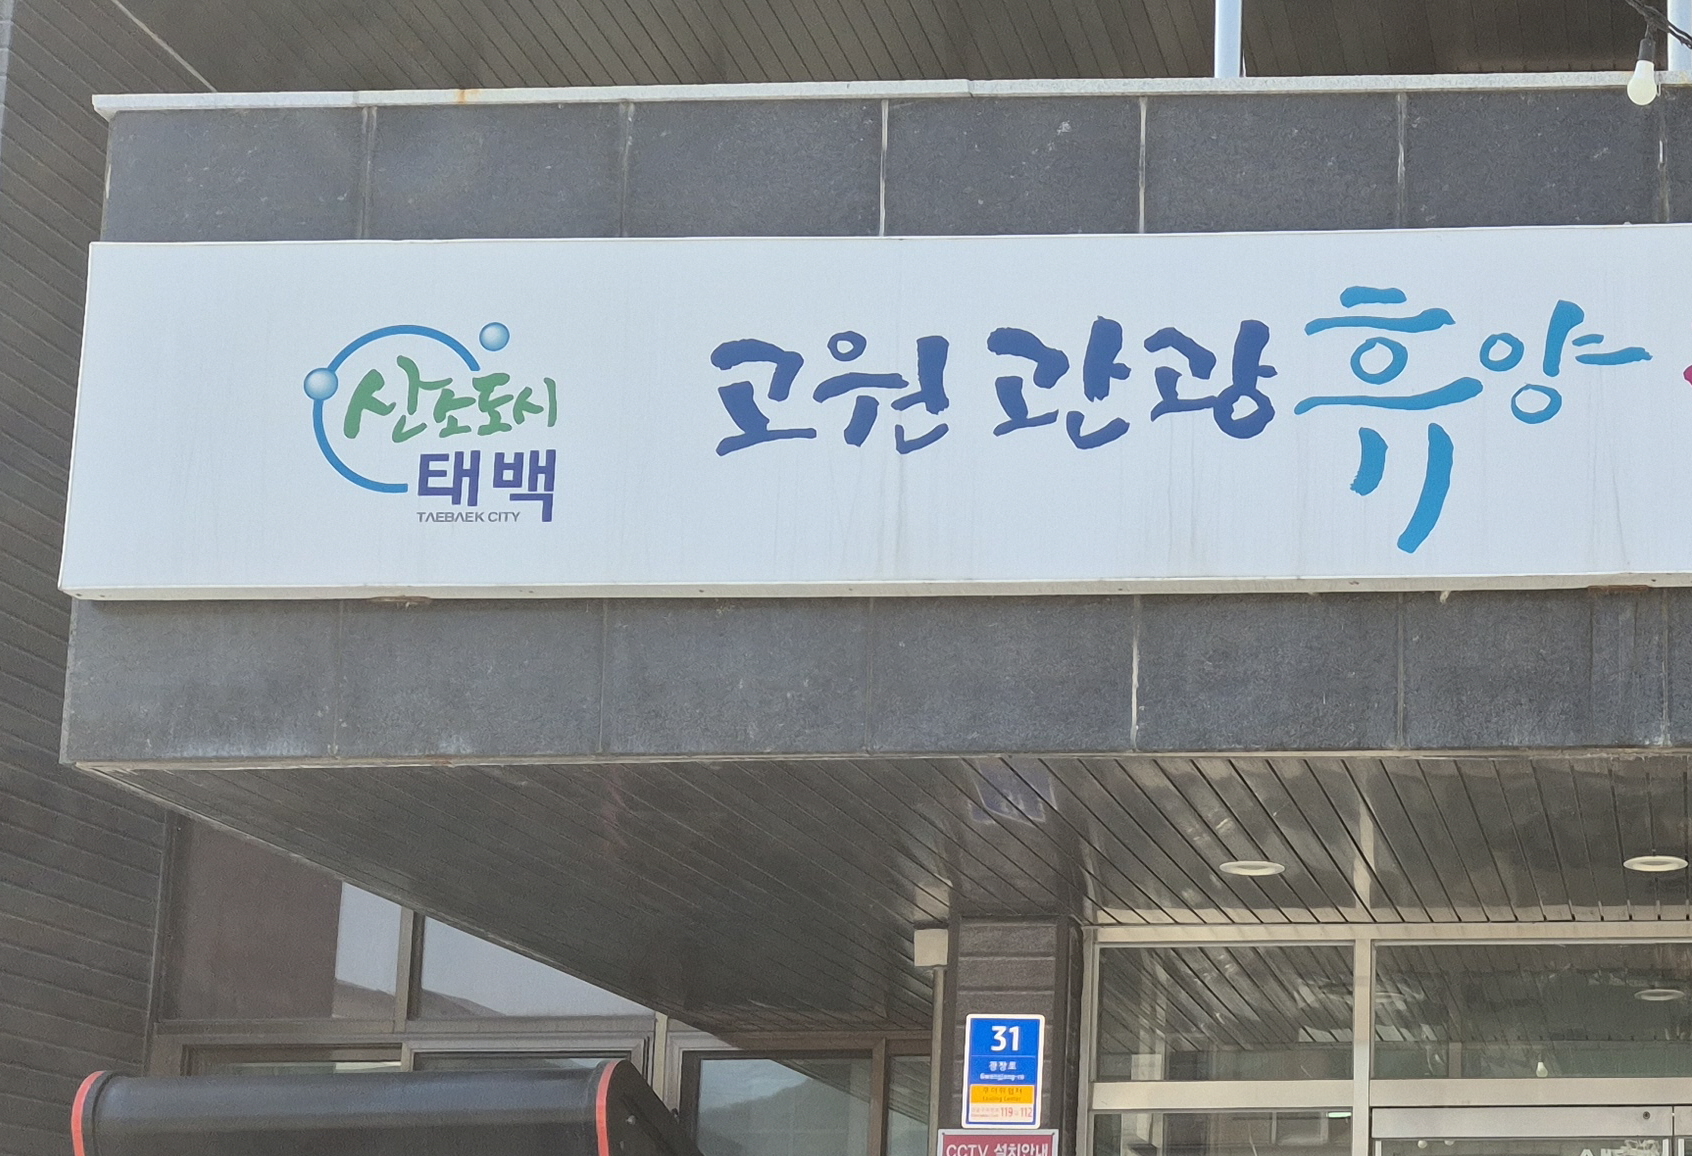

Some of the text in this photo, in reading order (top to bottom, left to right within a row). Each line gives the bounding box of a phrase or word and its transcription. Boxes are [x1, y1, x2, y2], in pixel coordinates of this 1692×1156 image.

[343, 355, 557, 443] 산소도시
[709, 330, 950, 456] 고원
[986, 314, 1278, 450] 관광
[1293, 285, 1653, 554] 휴양
[417, 449, 557, 522] 태백
[416, 511, 521, 522] TAEBAEK CITY
[991, 1026, 1019, 1051] 31
[1001, 1107, 1013, 1117] 119
[1020, 1107, 1032, 1117] 112
